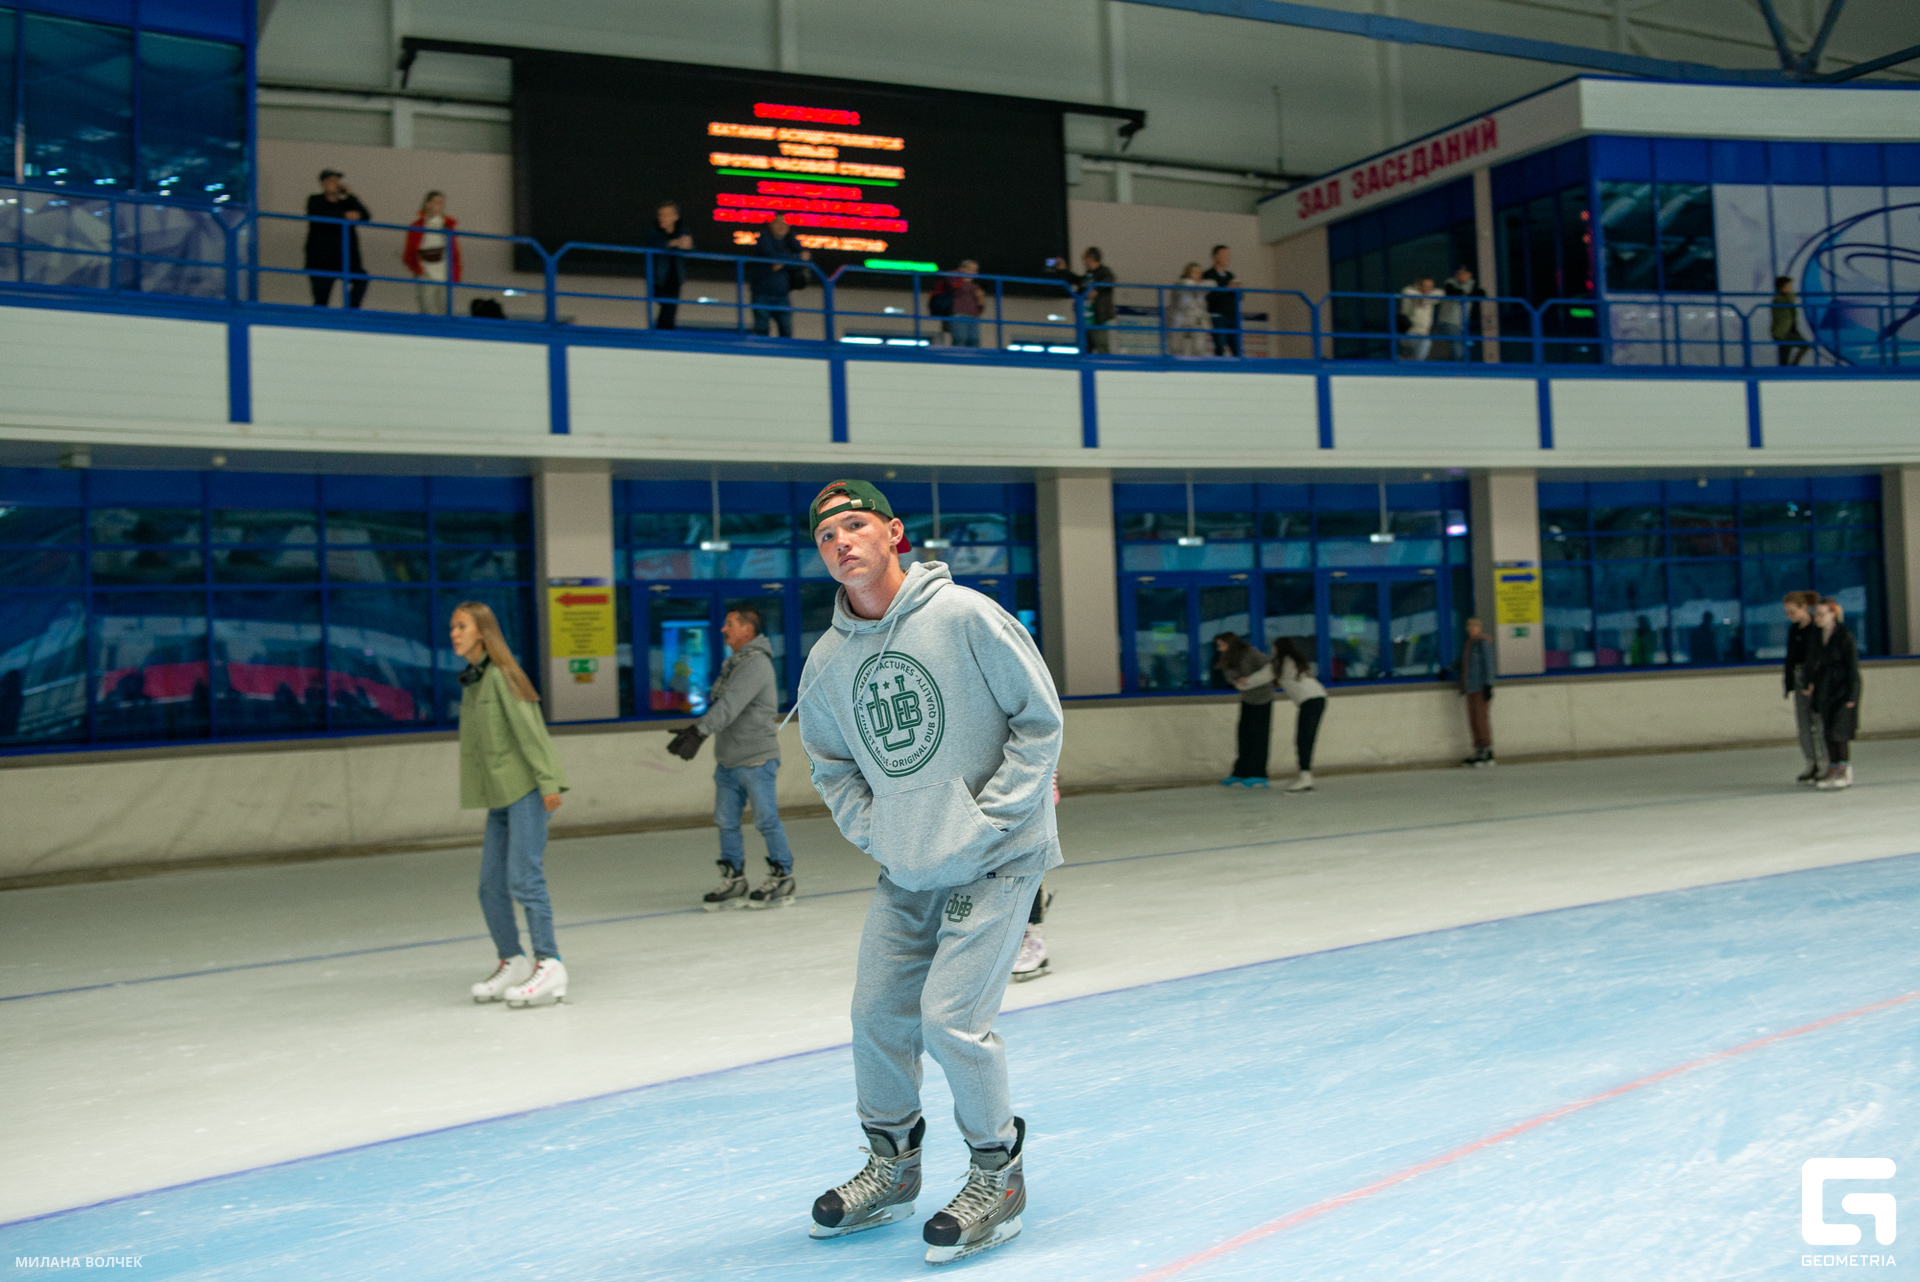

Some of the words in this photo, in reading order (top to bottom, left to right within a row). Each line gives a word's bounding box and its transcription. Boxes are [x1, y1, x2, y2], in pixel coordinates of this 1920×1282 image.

[1297, 180, 1342, 220] ЗАЛ
[1352, 115, 1498, 200] ЗАСЕДАНИЙ
[860, 660, 916, 690] MANACTURES
[916, 677, 937, 719] QUALITY
[860, 714, 876, 745] FINEST
[924, 721, 936, 743] DUB
[892, 744, 928, 768] ORIGINAL
